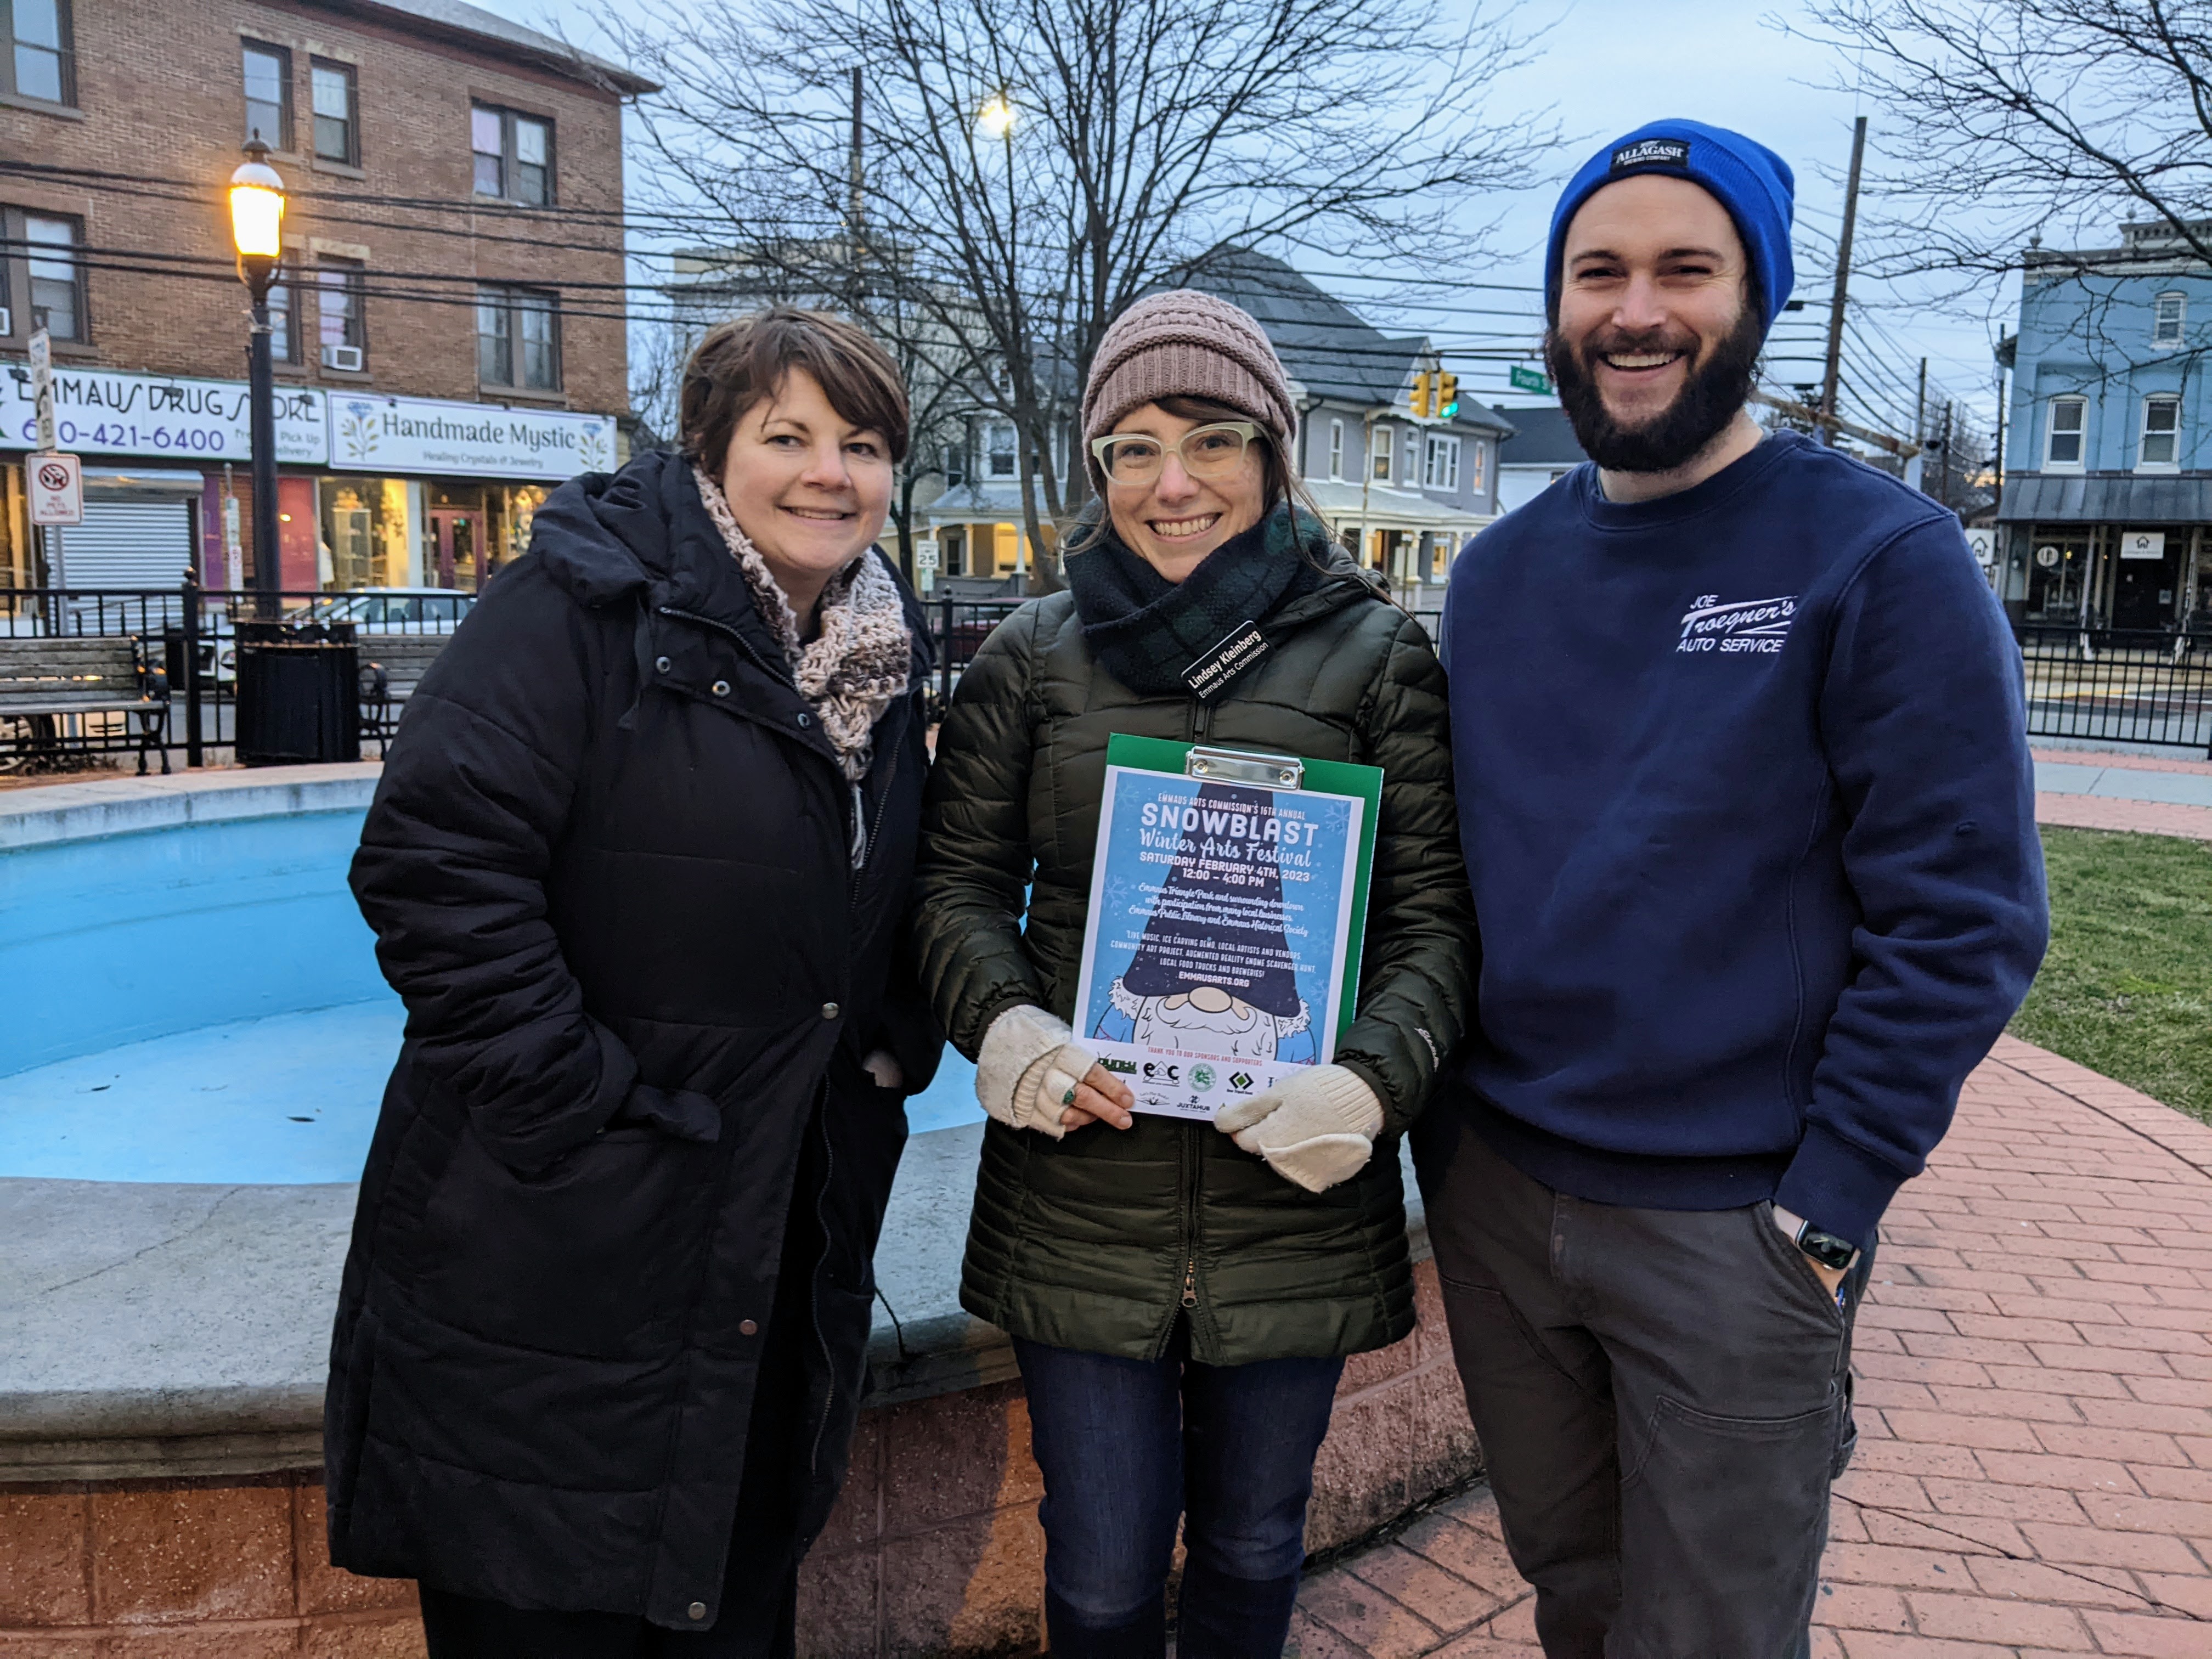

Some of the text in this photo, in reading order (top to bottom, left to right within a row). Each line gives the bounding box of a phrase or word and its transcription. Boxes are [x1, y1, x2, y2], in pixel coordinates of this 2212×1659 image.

[1616, 146, 1684, 163] ALLAGASH
[18, 376, 142, 413] EMAUS
[149, 385, 223, 416] DRUG
[22, 419, 224, 452] 60-421-6400
[383, 412, 576, 453] Handmade Mystic
[919, 554, 936, 566] 25
[1690, 594, 1719, 610] JOE
[1680, 595, 1799, 639] Troegner's
[1675, 637, 1785, 653] AUTO SERVICE
[1188, 630, 1262, 690] Lindsey Kleinberg
[1198, 642, 1269, 699] Emmaus Arts Commission
[1158, 793, 1306, 820] EMMAUS ARTS COMMISSION'S 16TH ANNUAL
[1141, 803, 1319, 847] SNOWBLAST
[1139, 827, 1312, 867] Winter Arts Festival
[1139, 851, 1310, 882] SATURDAY FEBRUARY 4TH, 2023
[1182, 868, 1210, 881] 12:00
[1222, 873, 1246, 885] 4:00
[1248, 876, 1265, 888] PM
[1138, 882, 1305, 911] Emmaus Triangle Park and surrounding downtown
[1144, 895, 1161, 906] with
[1161, 898, 1205, 912] participation
[1205, 902, 1222, 913] from
[1222, 906, 1242, 917] many
[1242, 907, 1258, 918] local
[1128, 905, 1309, 937] Emmaus Public Library and Emmaus Historical Society
[1110, 940, 1146, 952] COMMUNITY
[1146, 945, 1158, 953] ART
[1185, 950, 1220, 961] AUGMENTED
[1221, 953, 1244, 964] REALITY
[1245, 957, 1265, 967] GNOME
[1266, 960, 1299, 972] SCAVENGER
[1162, 935, 1172, 943] ICE
[1173, 936, 1198, 947] CARVING
[1218, 942, 1235, 952] LOCAL
[1237, 944, 1260, 955] ARTISTS
[1261, 947, 1274, 957] AND
[1159, 957, 1265, 978] LOCAL FOOD TRUCKS AND BREWERIES!
[1178, 971, 1250, 988] EMMAUSARTS.ORG
[1194, 1052, 1220, 1062] SPONSORS
[1232, 1057, 1263, 1066] SUPPORTERS
[1176, 1102, 1210, 1111] JUXTAHUB
